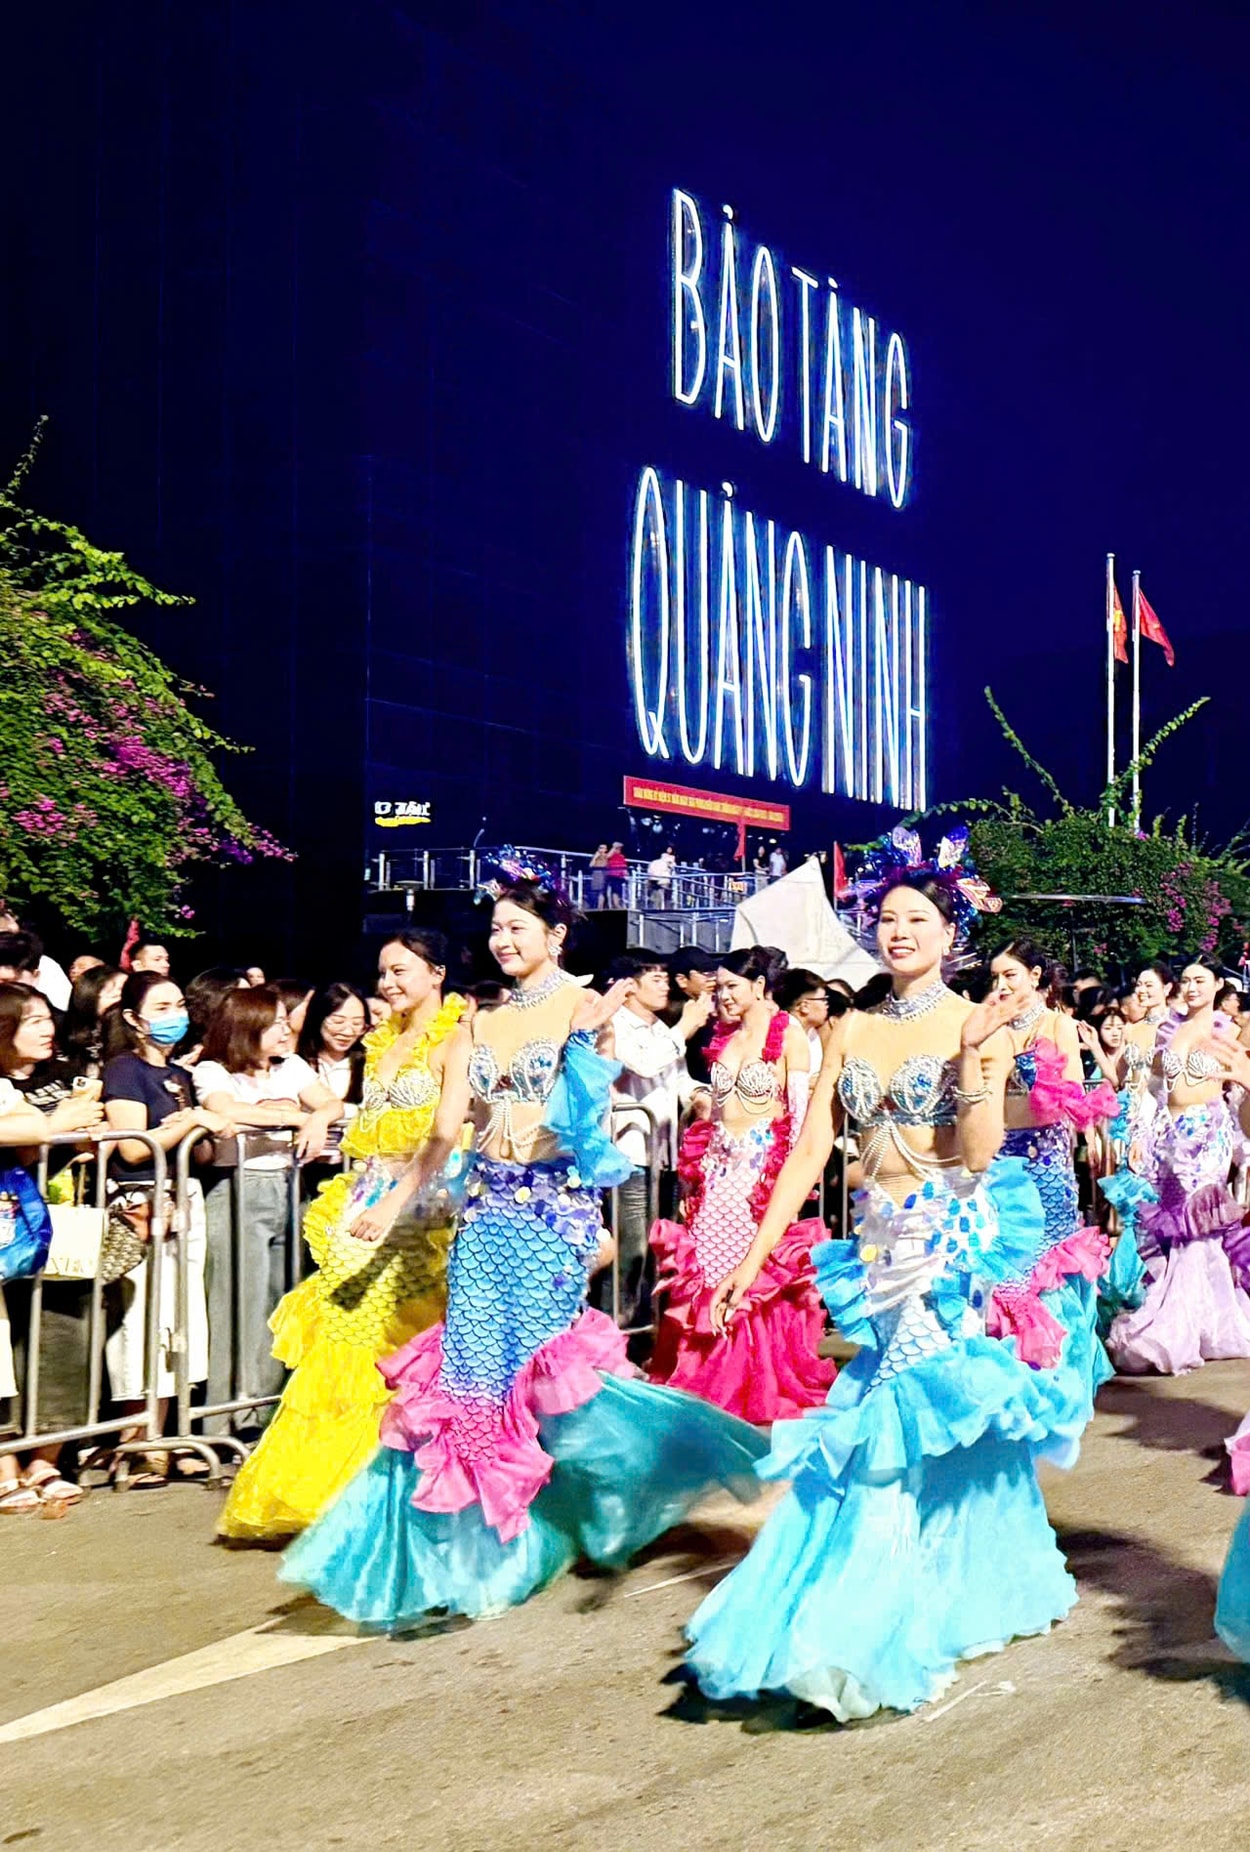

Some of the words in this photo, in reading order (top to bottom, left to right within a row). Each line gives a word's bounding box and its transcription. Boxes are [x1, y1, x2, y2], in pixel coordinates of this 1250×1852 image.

[672, 187, 780, 443] BẢO
[790, 265, 909, 509] TÀNG
[632, 465, 812, 787] QUẢNG
[822, 544, 926, 813] NINH
